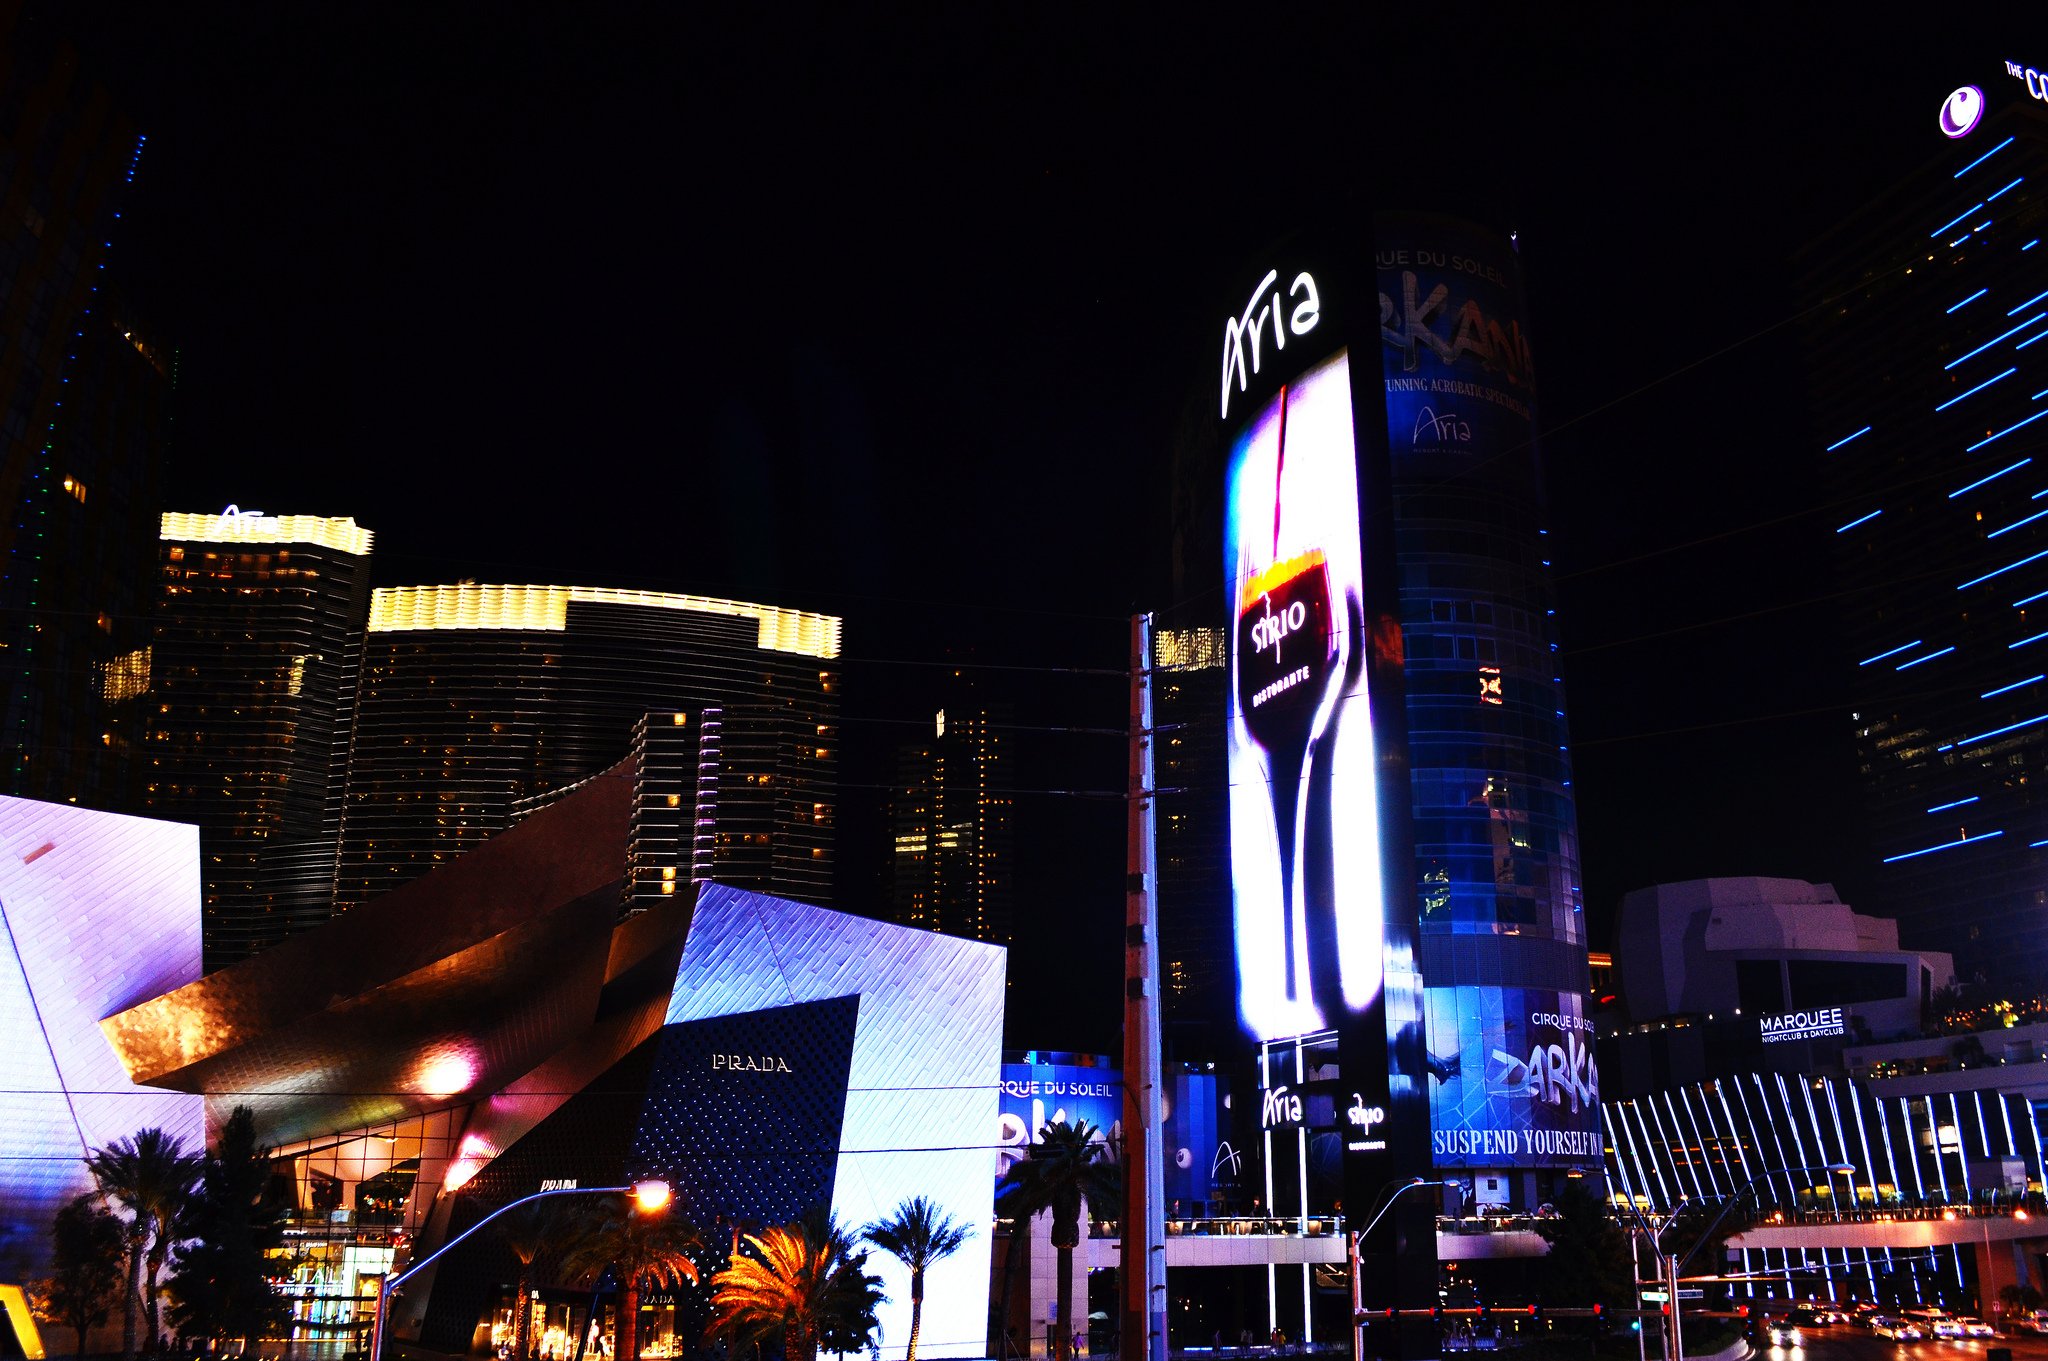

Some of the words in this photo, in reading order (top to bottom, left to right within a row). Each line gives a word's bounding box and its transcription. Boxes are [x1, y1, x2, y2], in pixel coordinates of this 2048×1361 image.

[2005, 61, 2024, 80] THE
[1417, 250, 1446, 268] DU
[1452, 255, 1508, 289] SOLEIL
[1221, 269, 1320, 419] Aria
[1431, 379, 1483, 400] ACROBATIC
[1413, 405, 1472, 445] Aria
[1531, 1012, 1571, 1031] CIRQUE
[1573, 1017, 1583, 1030] DU
[1760, 1008, 1843, 1032] MARQUEE
[1762, 1032, 1802, 1043] NIGHTCLUB
[1810, 1027, 1844, 1038] DAYCLUB
[712, 1054, 793, 1073] PRADA
[1045, 1082, 1066, 1095] DU
[1069, 1083, 1112, 1097] SOLEIL
[1262, 1086, 1302, 1129] Aria
[1434, 1130, 1518, 1155] SUSPEND
[1523, 1130, 1588, 1156] YOURSELF
